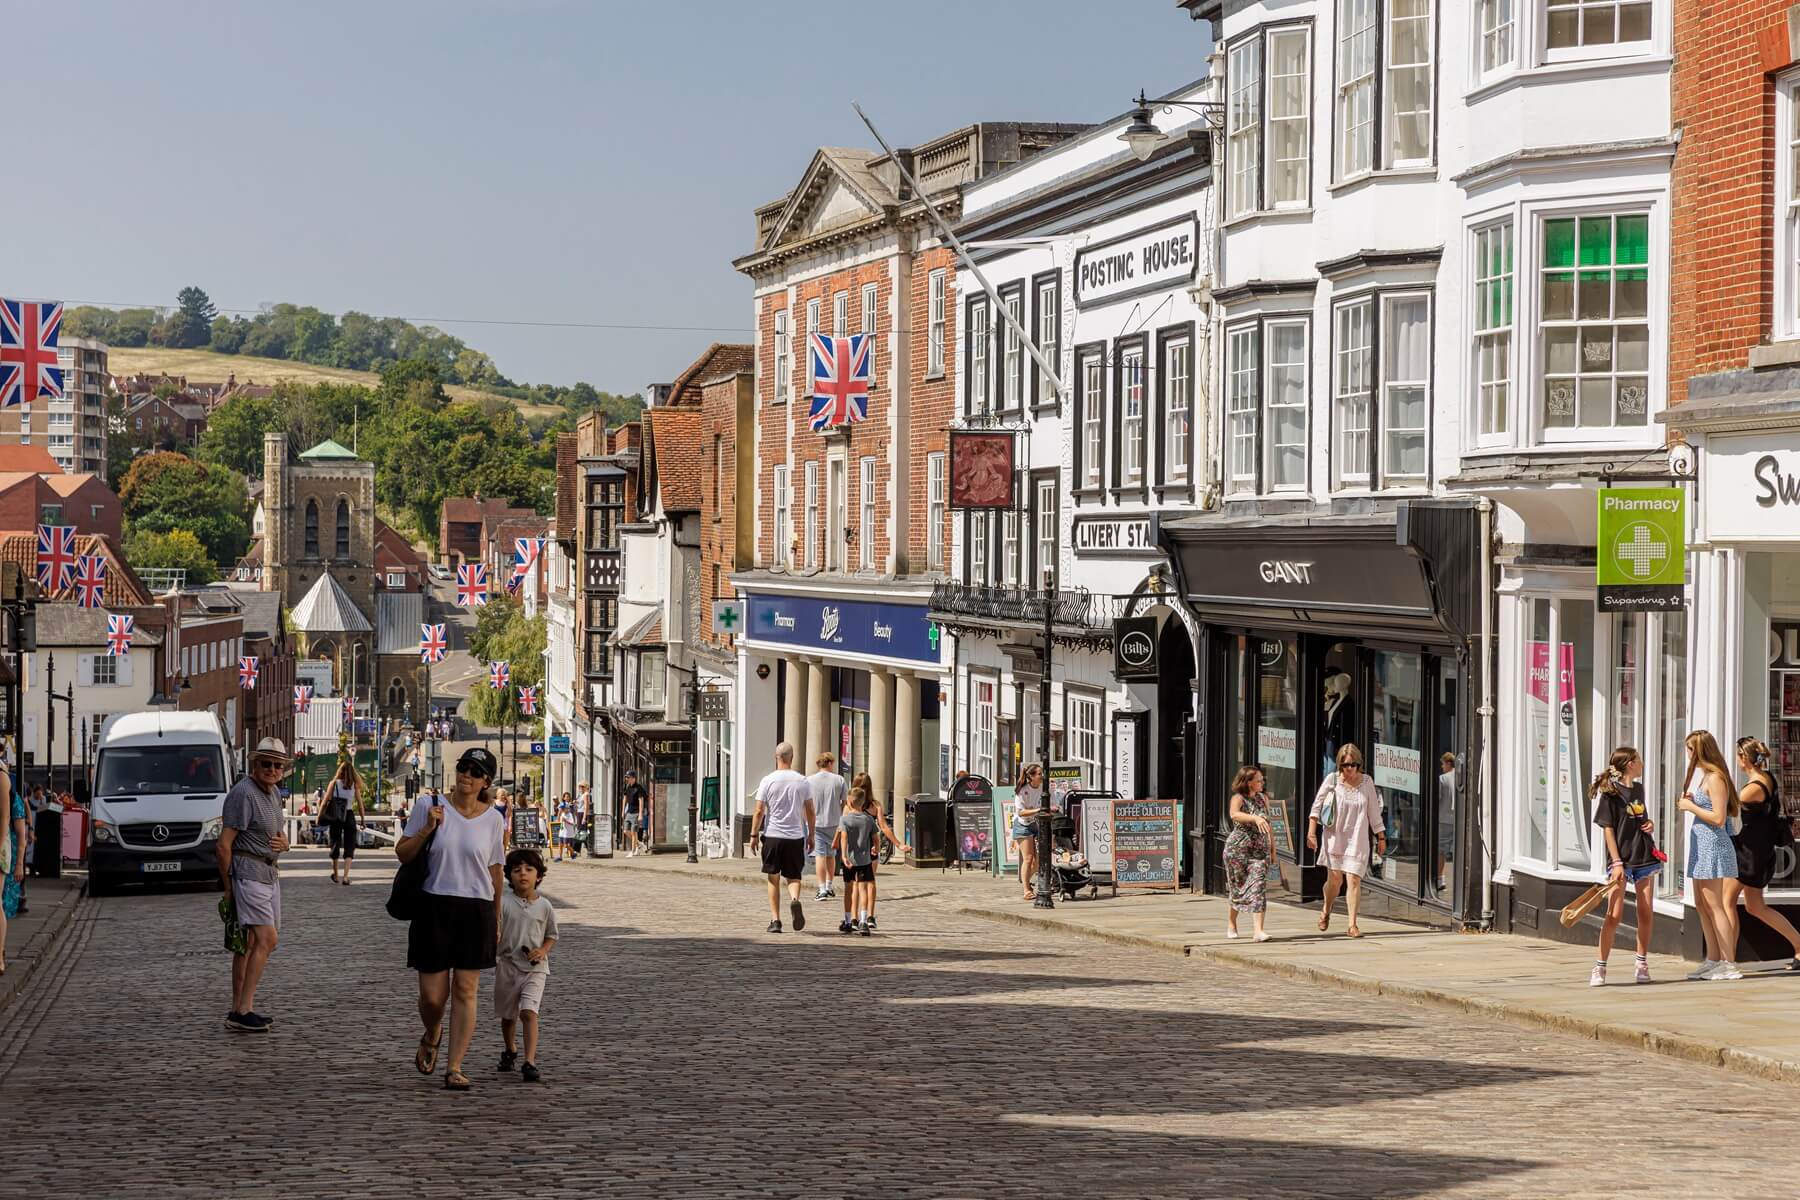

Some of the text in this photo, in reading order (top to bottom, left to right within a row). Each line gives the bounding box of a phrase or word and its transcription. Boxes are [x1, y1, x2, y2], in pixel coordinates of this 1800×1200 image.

[1604, 497, 1680, 512] Pharmacy
[1080, 523, 1121, 547] LIVERY
[1259, 560, 1313, 584] GANT
[1604, 595, 1666, 606] Superdrug
[774, 612, 796, 631] Pharmacy
[820, 606, 840, 641] Boots
[873, 621, 892, 642] Beauty
[1124, 641, 1149, 655] Bill's
[1530, 667, 1572, 683] PHARCY
[1375, 748, 1420, 774] Final Reductions
[1049, 769, 1079, 777] ENSWEAR
[1116, 806, 1172, 816] COFFEE CULTURE
[1099, 844, 1112, 854] O
